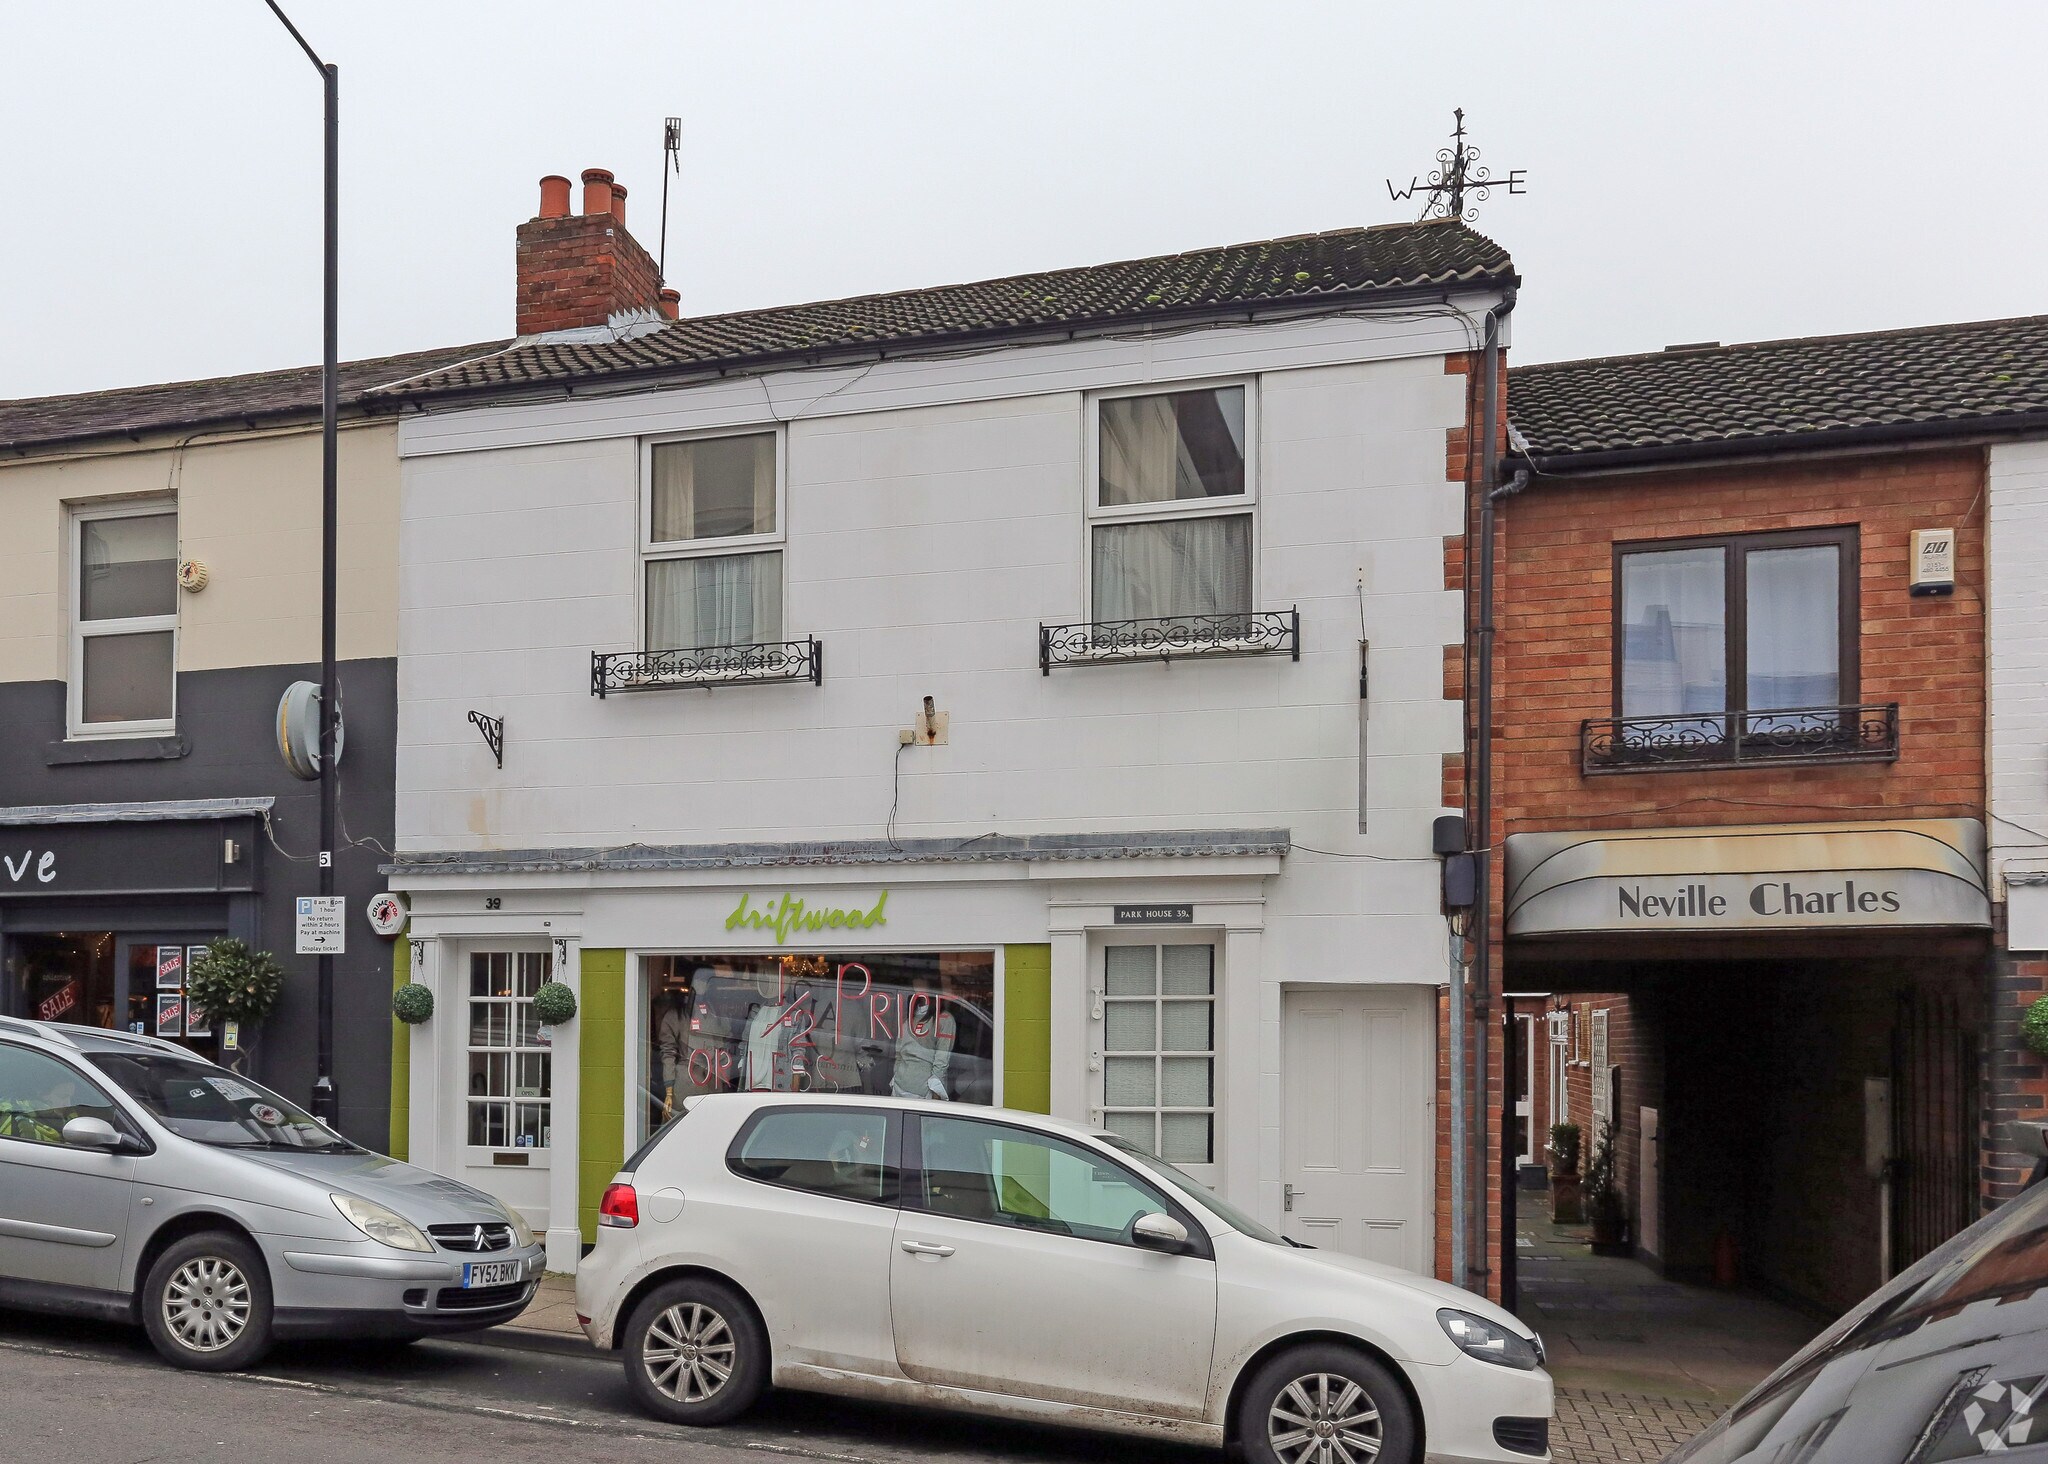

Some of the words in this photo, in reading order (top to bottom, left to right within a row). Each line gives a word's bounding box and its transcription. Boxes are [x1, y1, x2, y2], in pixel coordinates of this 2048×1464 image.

[1386, 176, 1417, 201] W
[1509, 170, 1527, 194] E
[320, 853, 328, 865] 5
[485, 897, 501, 910] 39
[1618, 884, 1727, 918] Neville
[1749, 880, 1900, 916] Charles
[725, 890, 887, 945] driftwood
[1120, 910, 1142, 918] PARK
[1146, 910, 1172, 918] HOUSE
[160, 957, 180, 974] SALE
[41, 987, 74, 1021] SALE
[160, 1006, 180, 1023] SALE
[687, 1048, 733, 1092] OR
[471, 1264, 498, 1284] FY52
[499, 1262, 516, 1282] BKK
